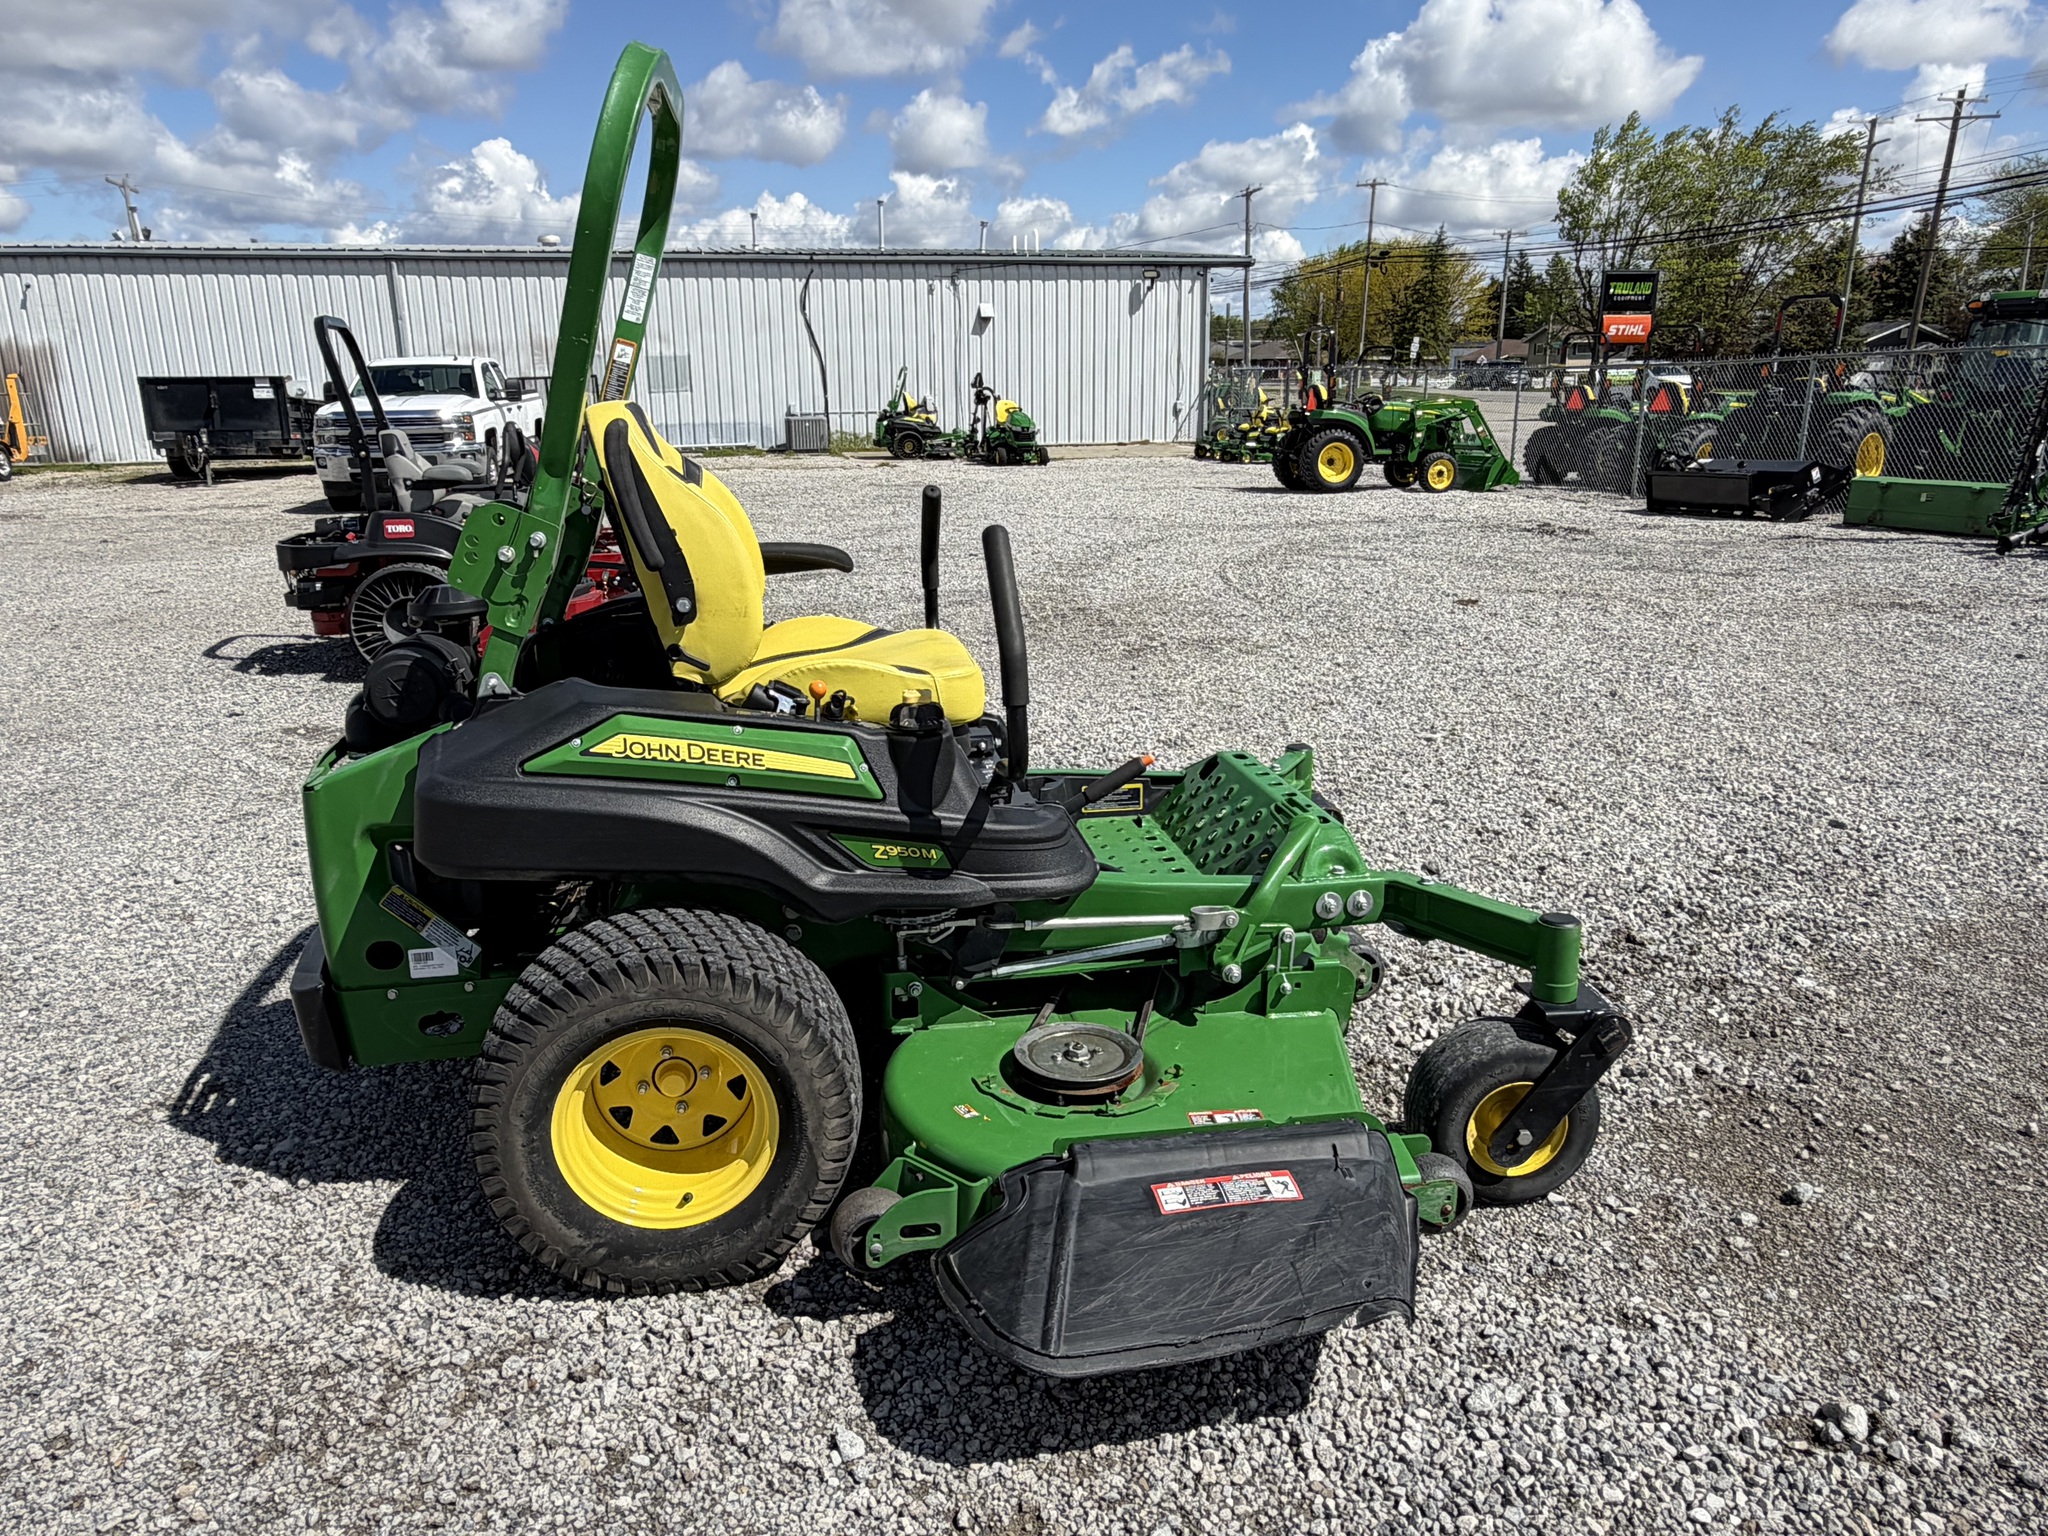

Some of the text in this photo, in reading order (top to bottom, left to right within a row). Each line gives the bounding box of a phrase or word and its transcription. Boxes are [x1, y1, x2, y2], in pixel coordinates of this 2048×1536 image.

[1609, 282, 1653, 295] TRULAND
[1607, 324, 1645, 335] STIHL
[386, 524, 413, 533] TORO
[614, 737, 767, 768] JOHN DEERE
[871, 844, 938, 860] Z950M
